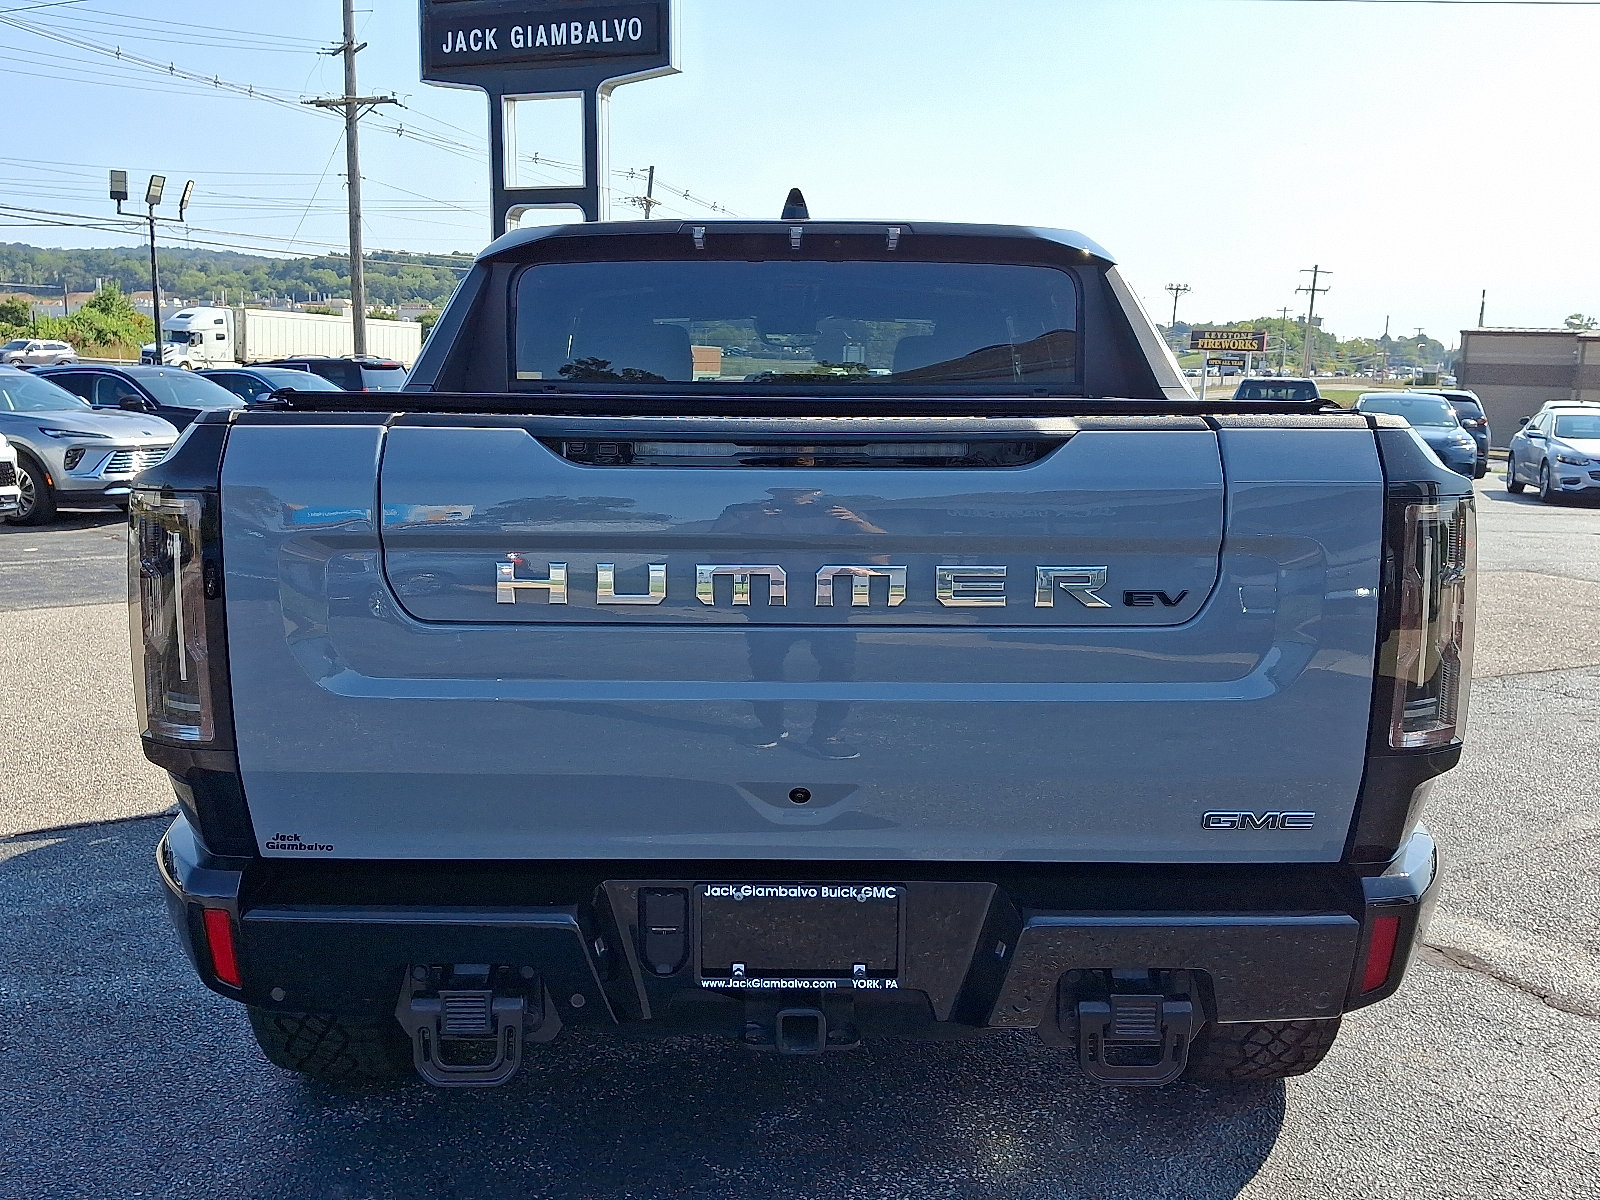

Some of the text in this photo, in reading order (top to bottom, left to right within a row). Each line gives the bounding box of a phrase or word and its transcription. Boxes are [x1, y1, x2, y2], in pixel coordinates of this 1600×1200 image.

[442, 17, 643, 54] JACK GIAMBALVO
[1197, 338, 1258, 350] FIREWORKS
[496, 562, 1189, 607] HUMMER EV
[1202, 810, 1316, 830] GMC
[271, 832, 301, 842] Jack
[265, 841, 334, 851] Giambalvo
[704, 885, 897, 899] Jack Giambalvo Buick GMC
[701, 978, 837, 988] www.JackGiambalvo.com
[852, 979, 899, 989] YORK, PA
